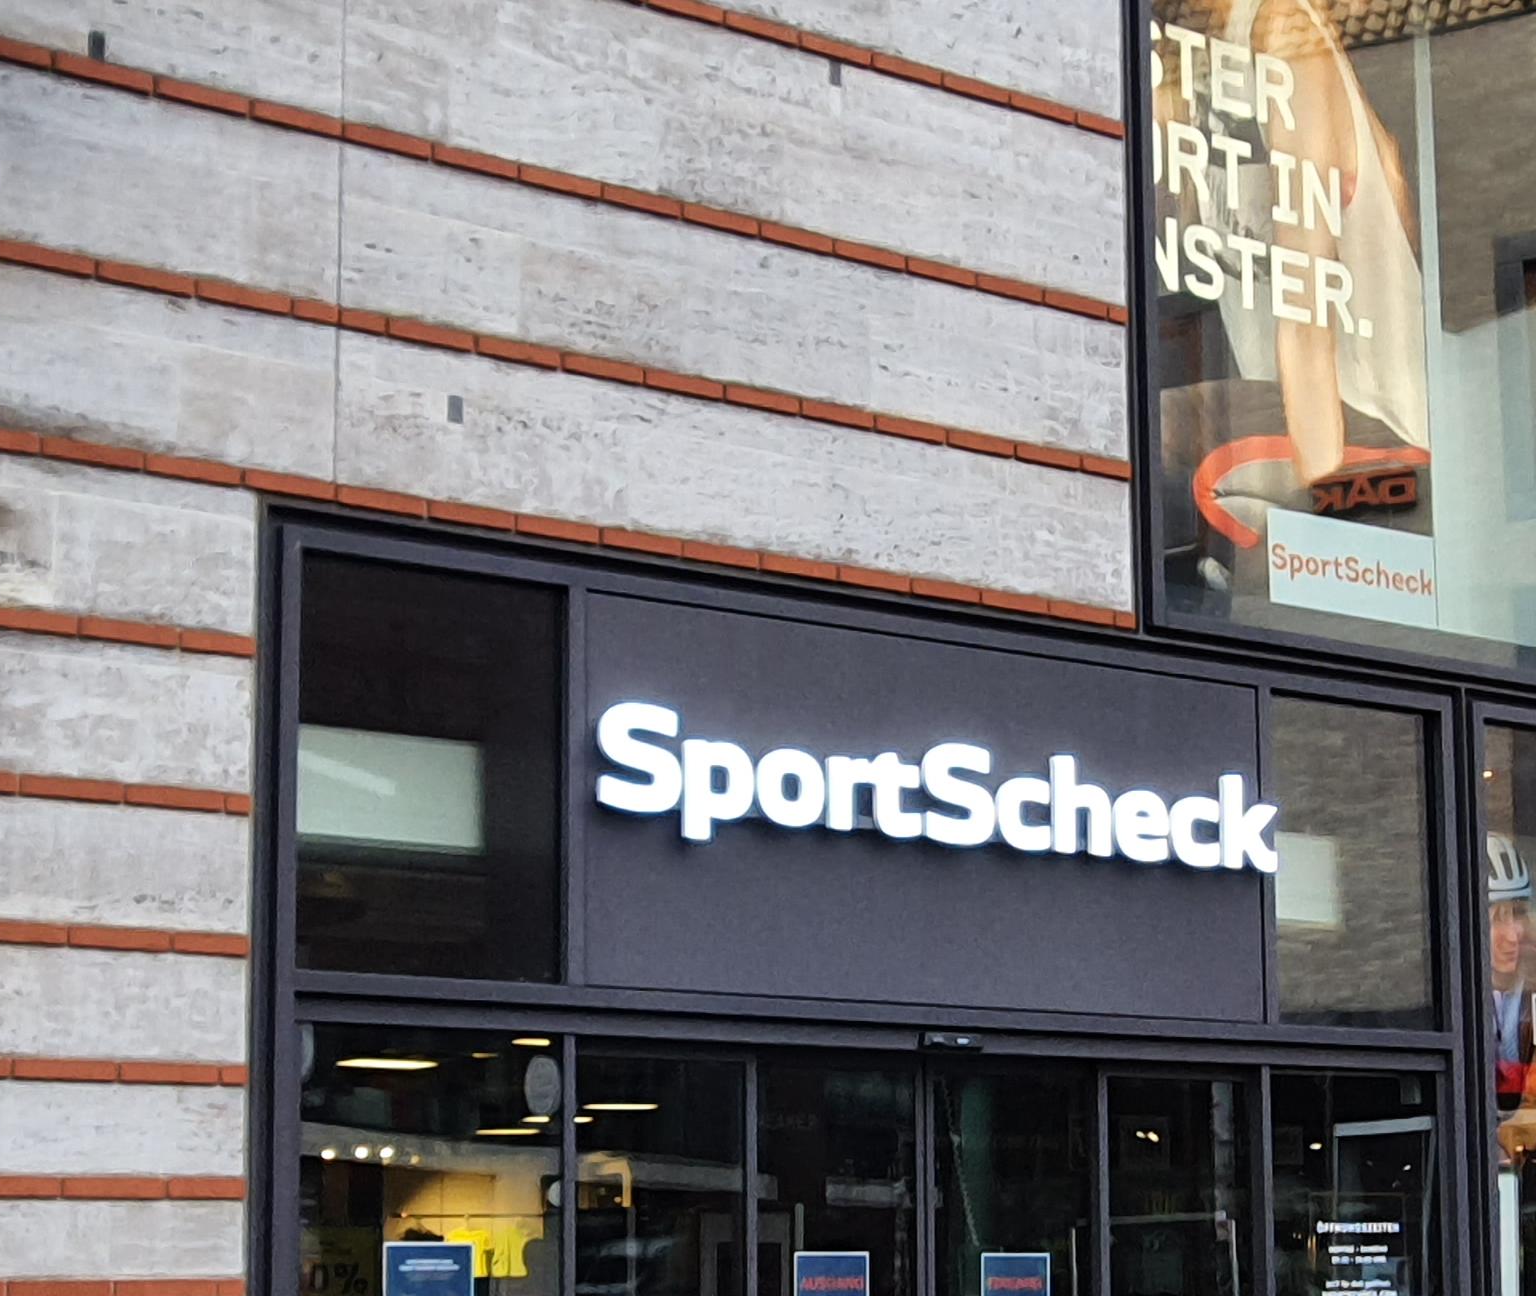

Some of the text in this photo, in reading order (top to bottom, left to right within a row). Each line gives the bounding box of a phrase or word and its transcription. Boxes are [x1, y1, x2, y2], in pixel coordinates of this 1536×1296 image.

[1270, 149, 1343, 237] IN
[1270, 543, 1433, 596] SportScheck
[595, 700, 1280, 874] SportScheck
